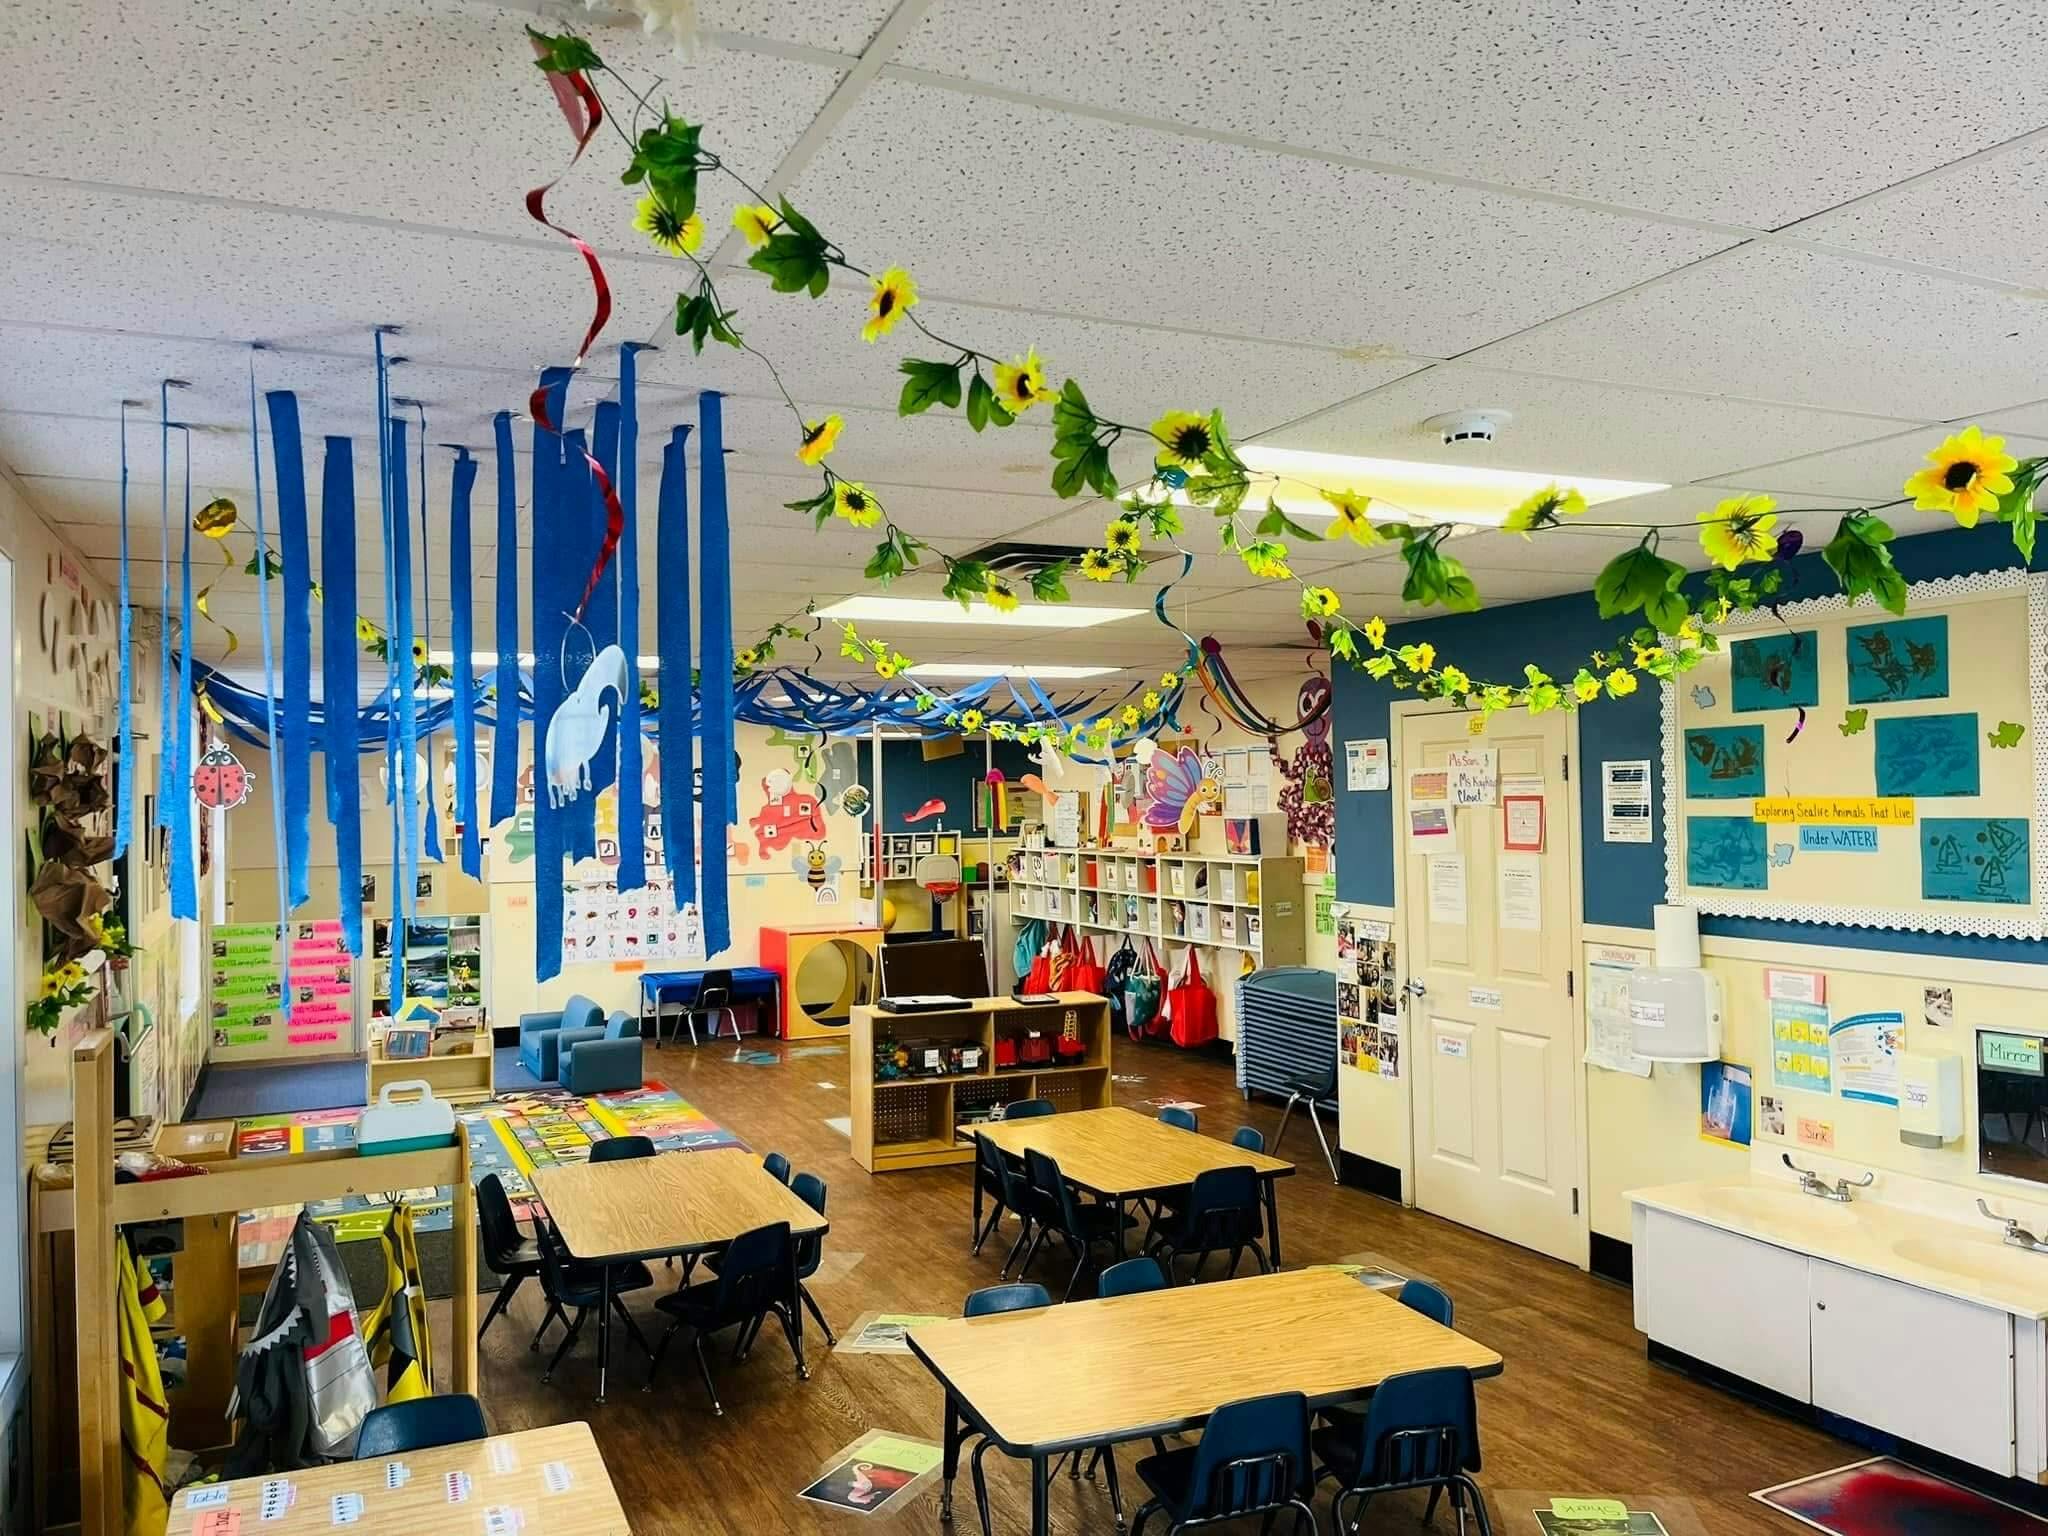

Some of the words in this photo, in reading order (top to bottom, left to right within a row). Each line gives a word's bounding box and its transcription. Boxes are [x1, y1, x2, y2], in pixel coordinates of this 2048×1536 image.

[1754, 802, 1795, 822] Exploring
[1833, 803, 1865, 818] Animals
[1869, 803, 1889, 818] That
[1894, 804, 1912, 819] Live
[1803, 830, 1830, 845] Under
[1830, 830, 1877, 847] WATER!
[1990, 1042, 2034, 1064] Mirror
[1906, 1088, 1928, 1108] Soap
[1805, 1123, 1829, 1143] Sink
[192, 1489, 227, 1504] Table
